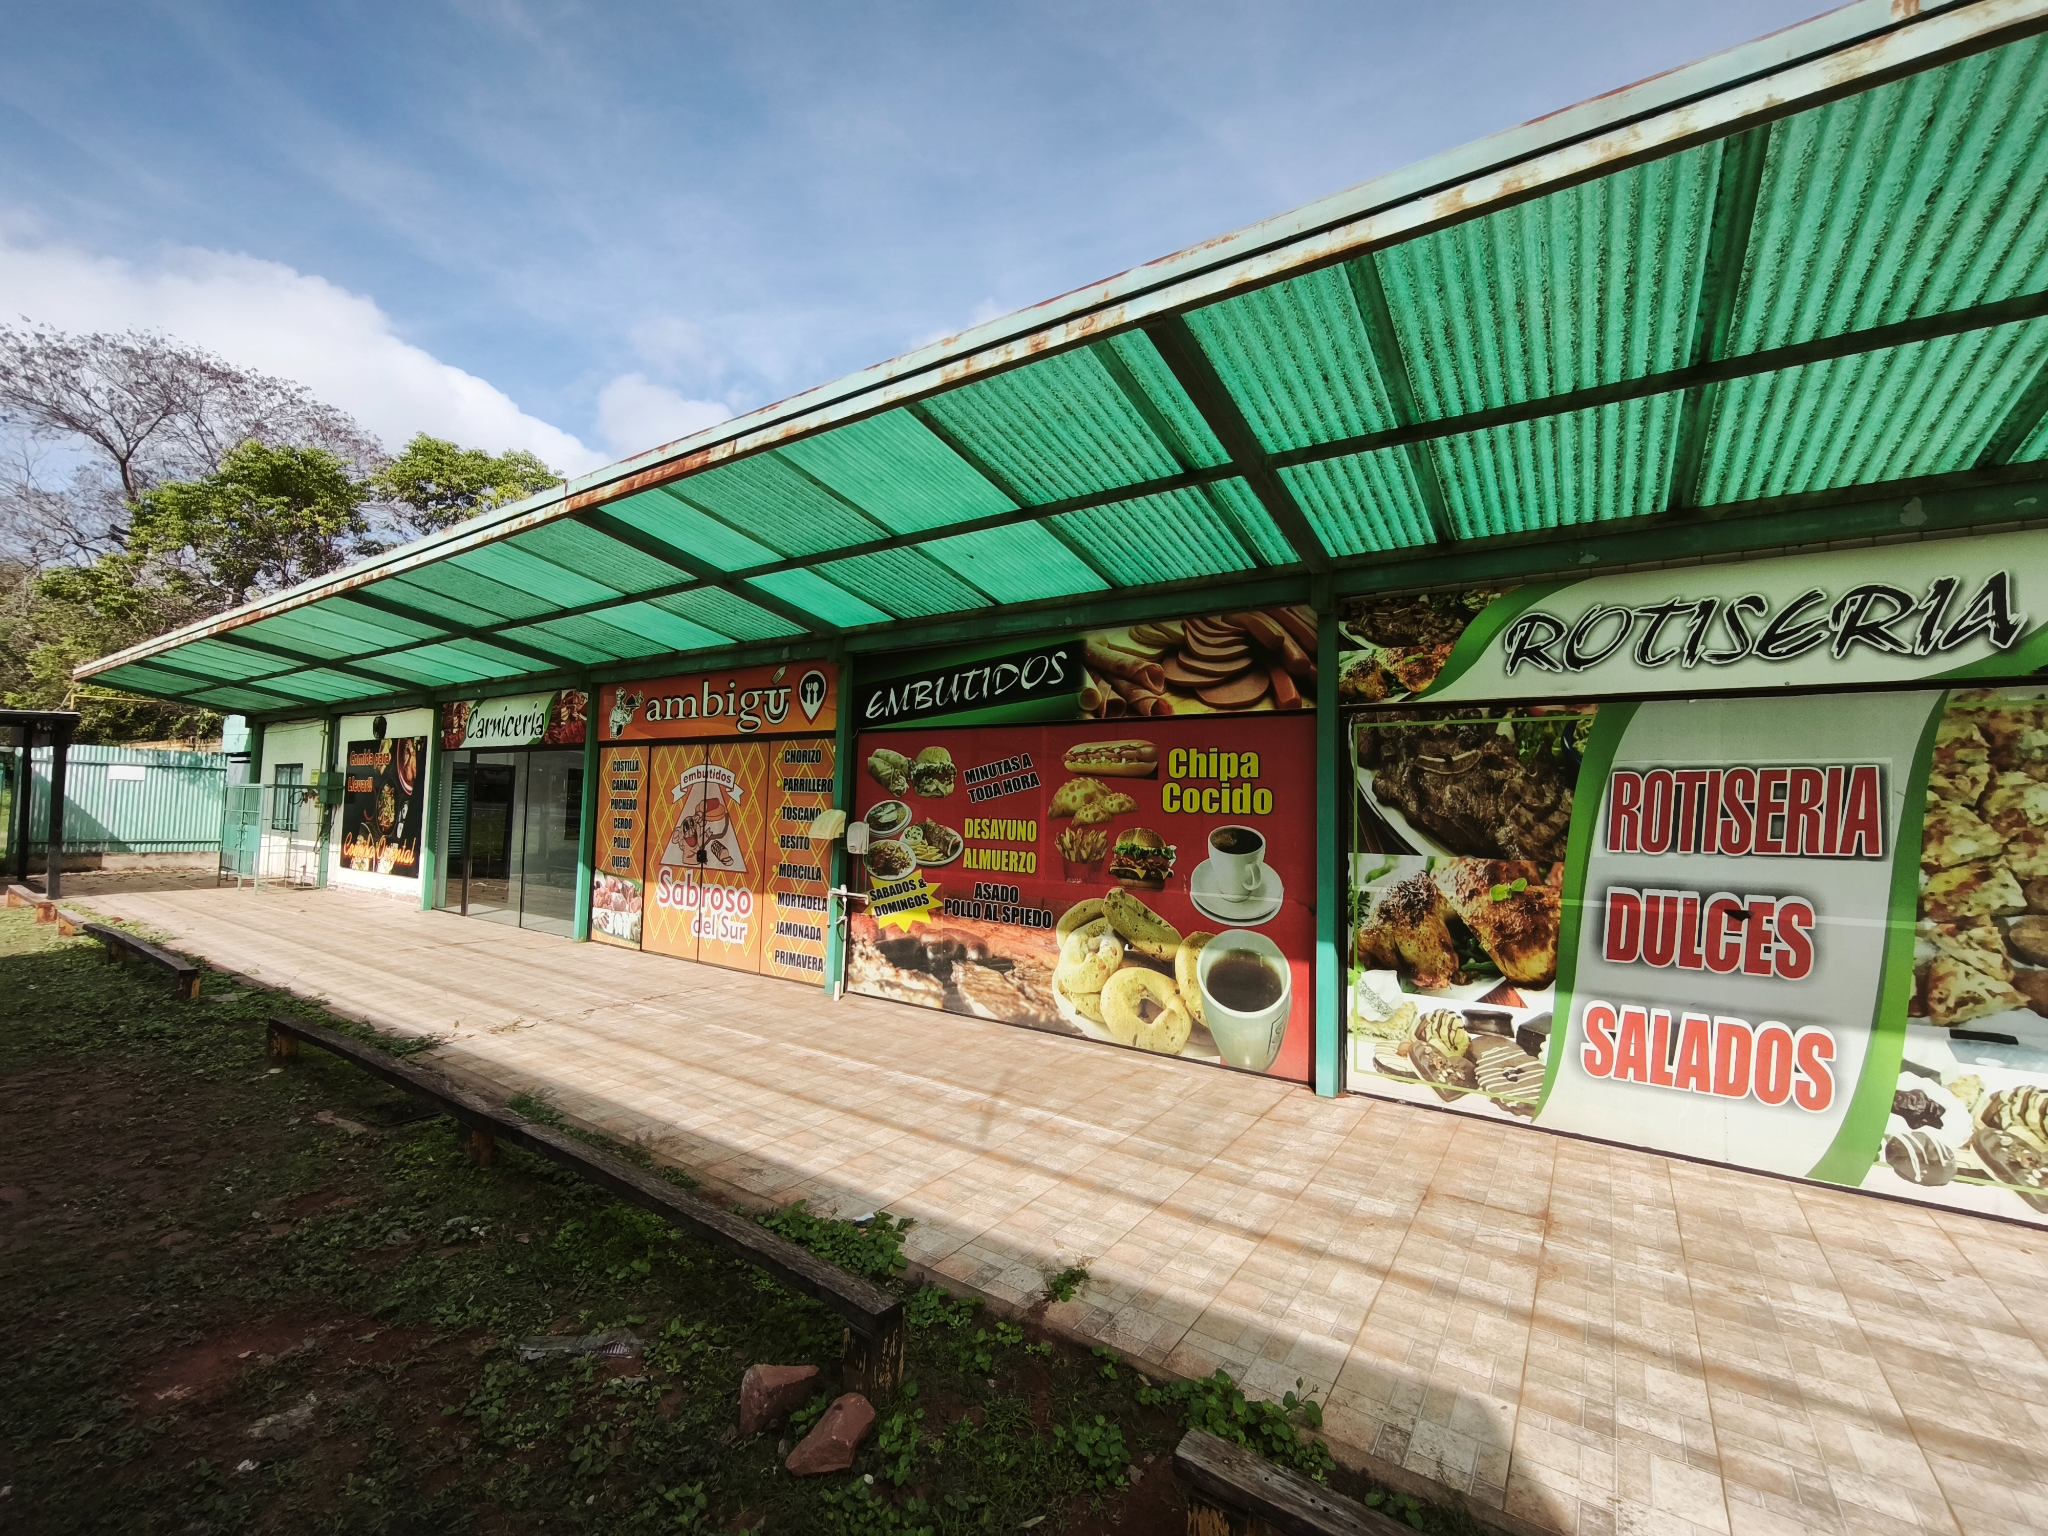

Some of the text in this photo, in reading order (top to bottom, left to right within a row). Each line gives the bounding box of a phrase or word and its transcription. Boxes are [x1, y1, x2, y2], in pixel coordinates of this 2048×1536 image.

[1503, 570, 2028, 676] ROTISERIA
[865, 650, 1068, 719] EMBUTIDOS
[645, 666, 792, 734] ambigú
[467, 702, 545, 739] Carniceria
[350, 749, 392, 770] Comida para
[612, 760, 640, 773] COSTILLA
[784, 749, 822, 764] CHORIZO
[1168, 747, 1260, 782] Chipa
[683, 768, 732, 784] embutidos
[963, 753, 1033, 785] MINUTAS A
[611, 779, 638, 792] CARNAZA
[782, 778, 834, 793] PARRILLERO
[967, 772, 1041, 803] TODA HORA
[610, 798, 638, 811] PUCHERO
[1162, 782, 1273, 815] Cocido
[1607, 764, 1884, 857] ROTISERIA
[613, 817, 633, 830] CERDO
[964, 818, 1037, 842] DESAYUNO
[343, 832, 417, 865] Comida Oriental
[613, 836, 631, 849] POLLO
[780, 834, 811, 851] BESITO
[611, 856, 631, 869] QUESO
[778, 863, 822, 882] MORCILLA
[962, 848, 1037, 874] ALMUERZO
[658, 868, 753, 917] Sabroso
[777, 891, 828, 913] MORTADELA
[869, 878, 928, 902] SABADOS &
[973, 882, 1020, 904] ASADO
[874, 893, 930, 917] DOMINGOS
[943, 898, 1054, 929] POLLO AL SPIEDO
[692, 912, 748, 943] del Sur
[776, 920, 823, 941] JAMONADA
[1604, 887, 1815, 981] DULCES
[774, 949, 824, 973] PRIMAVERA
[1581, 1000, 1837, 1113] SALADOS
